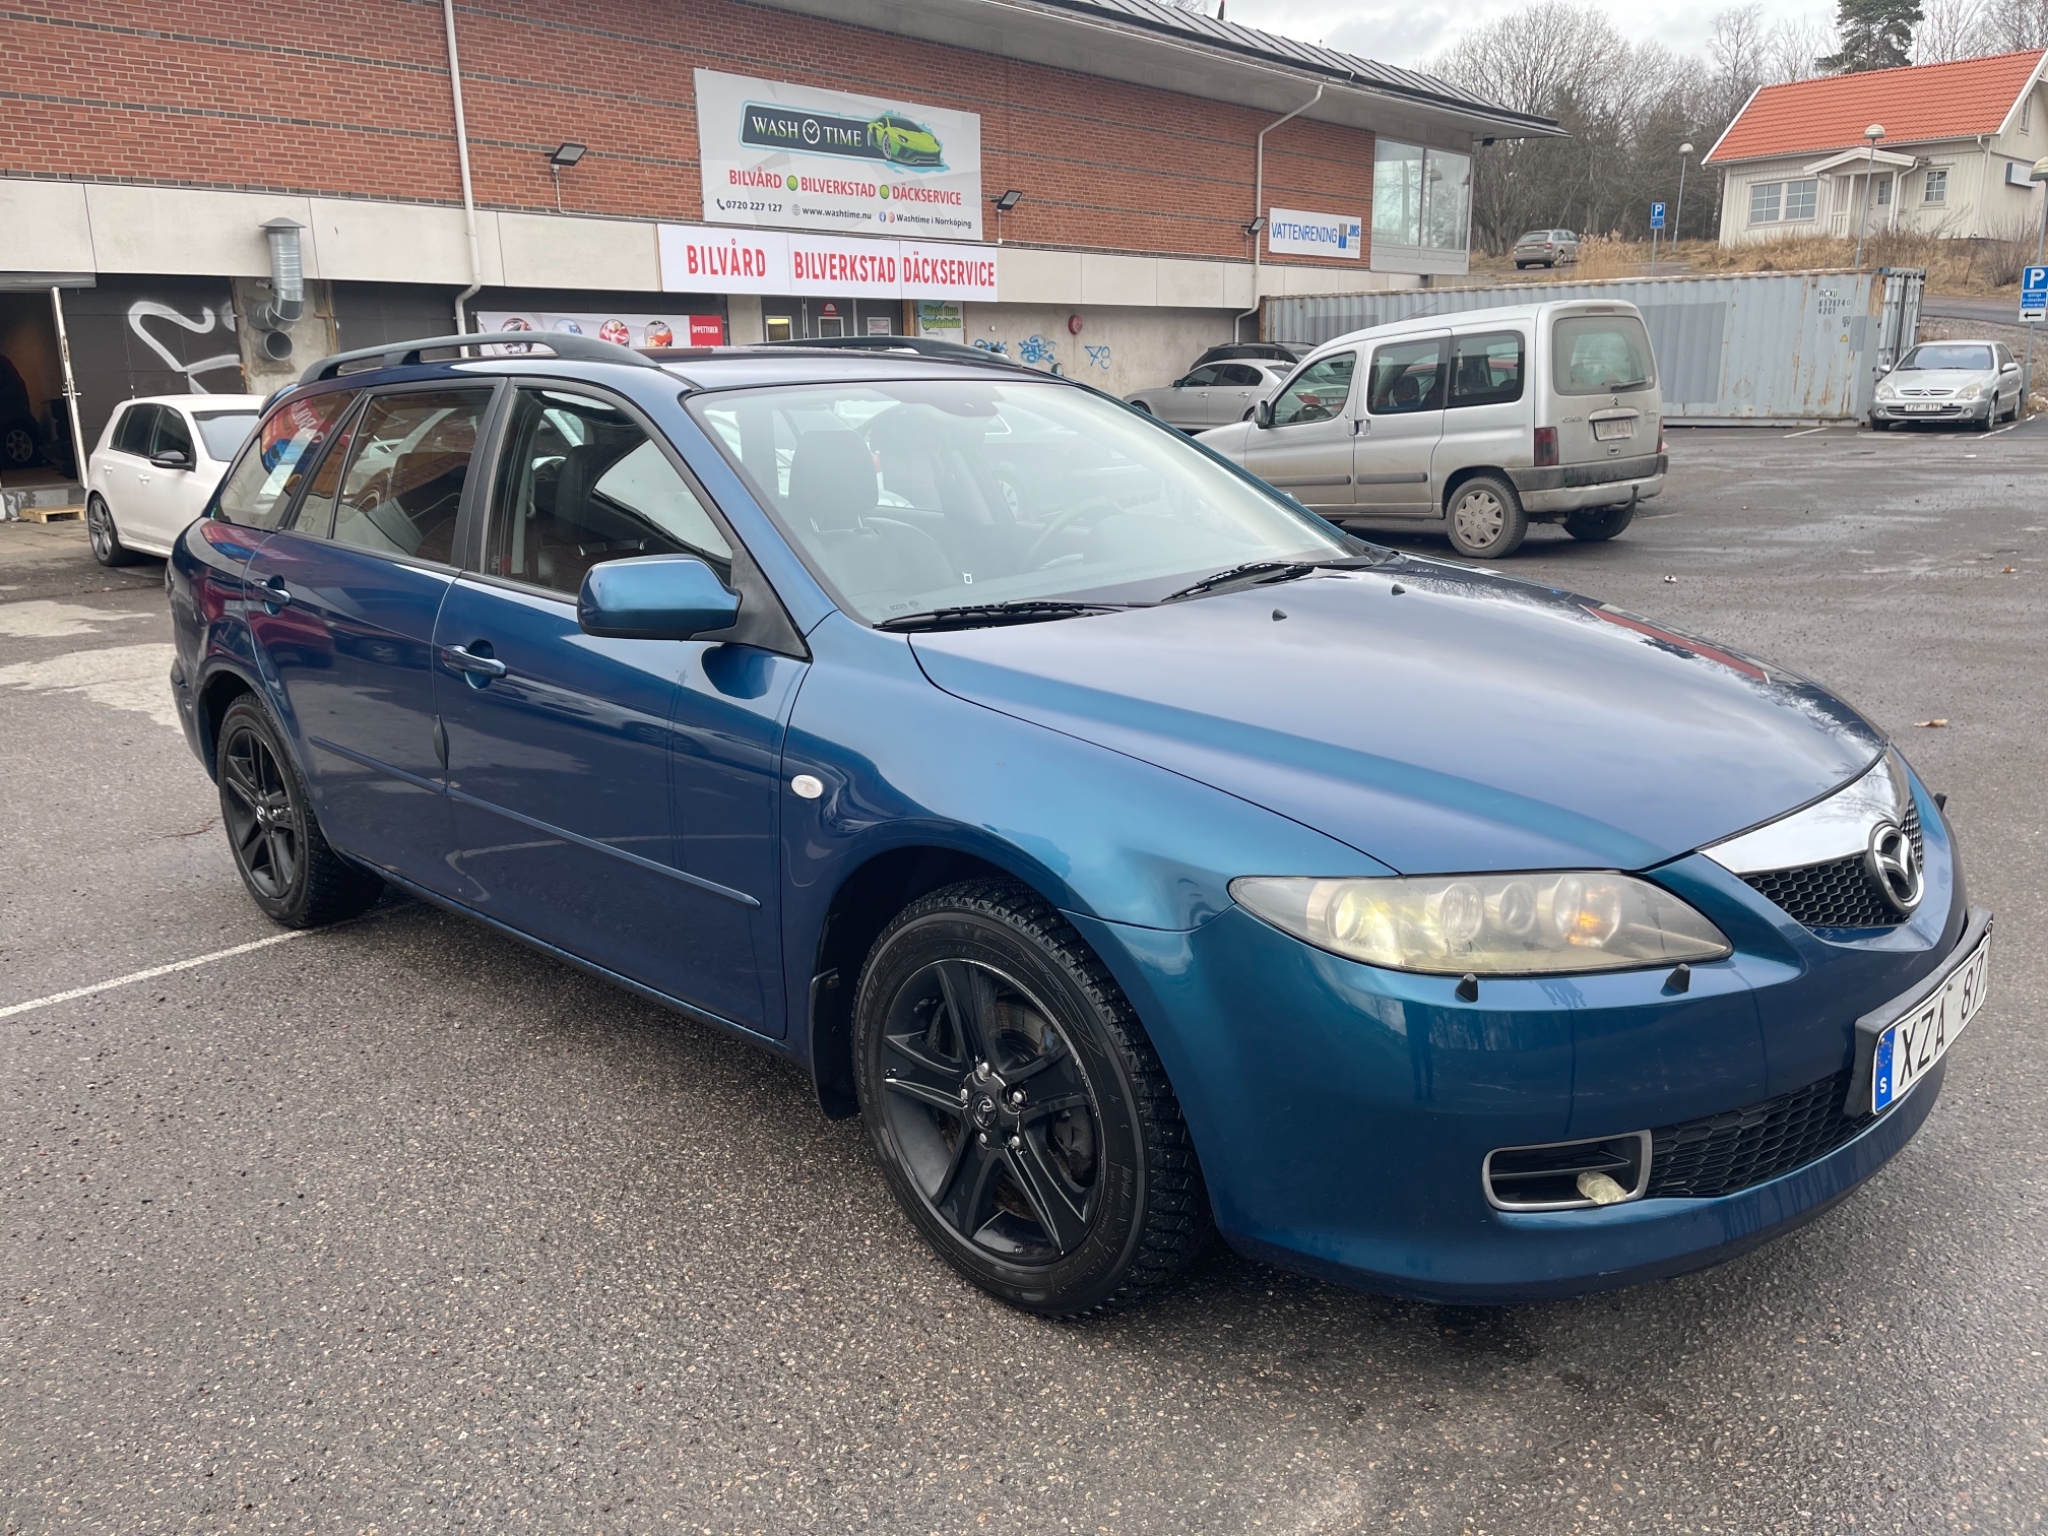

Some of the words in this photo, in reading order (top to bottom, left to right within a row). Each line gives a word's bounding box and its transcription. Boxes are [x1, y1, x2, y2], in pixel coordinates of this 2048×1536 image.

[752, 115, 799, 139] WASH
[823, 125, 862, 148] TIME
[729, 166, 782, 189] BILVÅRD
[801, 176, 876, 198] BILVERKSTAD
[892, 181, 962, 206] DÄCKSERVICE
[726, 200, 748, 210] 0720
[749, 201, 765, 211] 227
[768, 202, 782, 213] 127
[802, 206, 872, 220] www.washtime.nu
[1655, 204, 1663, 216] P
[896, 213, 930, 225] Washtime
[935, 216, 972, 230] Norrköping
[1348, 224, 1360, 238] JMS
[1271, 222, 1338, 244] VATTENRENING
[687, 238, 766, 278] BILVÅRD
[793, 251, 896, 284] BILVERKSTAD
[903, 251, 995, 288] DÄCKSERVICE
[2029, 268, 2046, 289] P
[1899, 996, 1946, 1088] XZA
[1961, 949, 1986, 1021] 87
[1879, 1076, 1888, 1094] S
